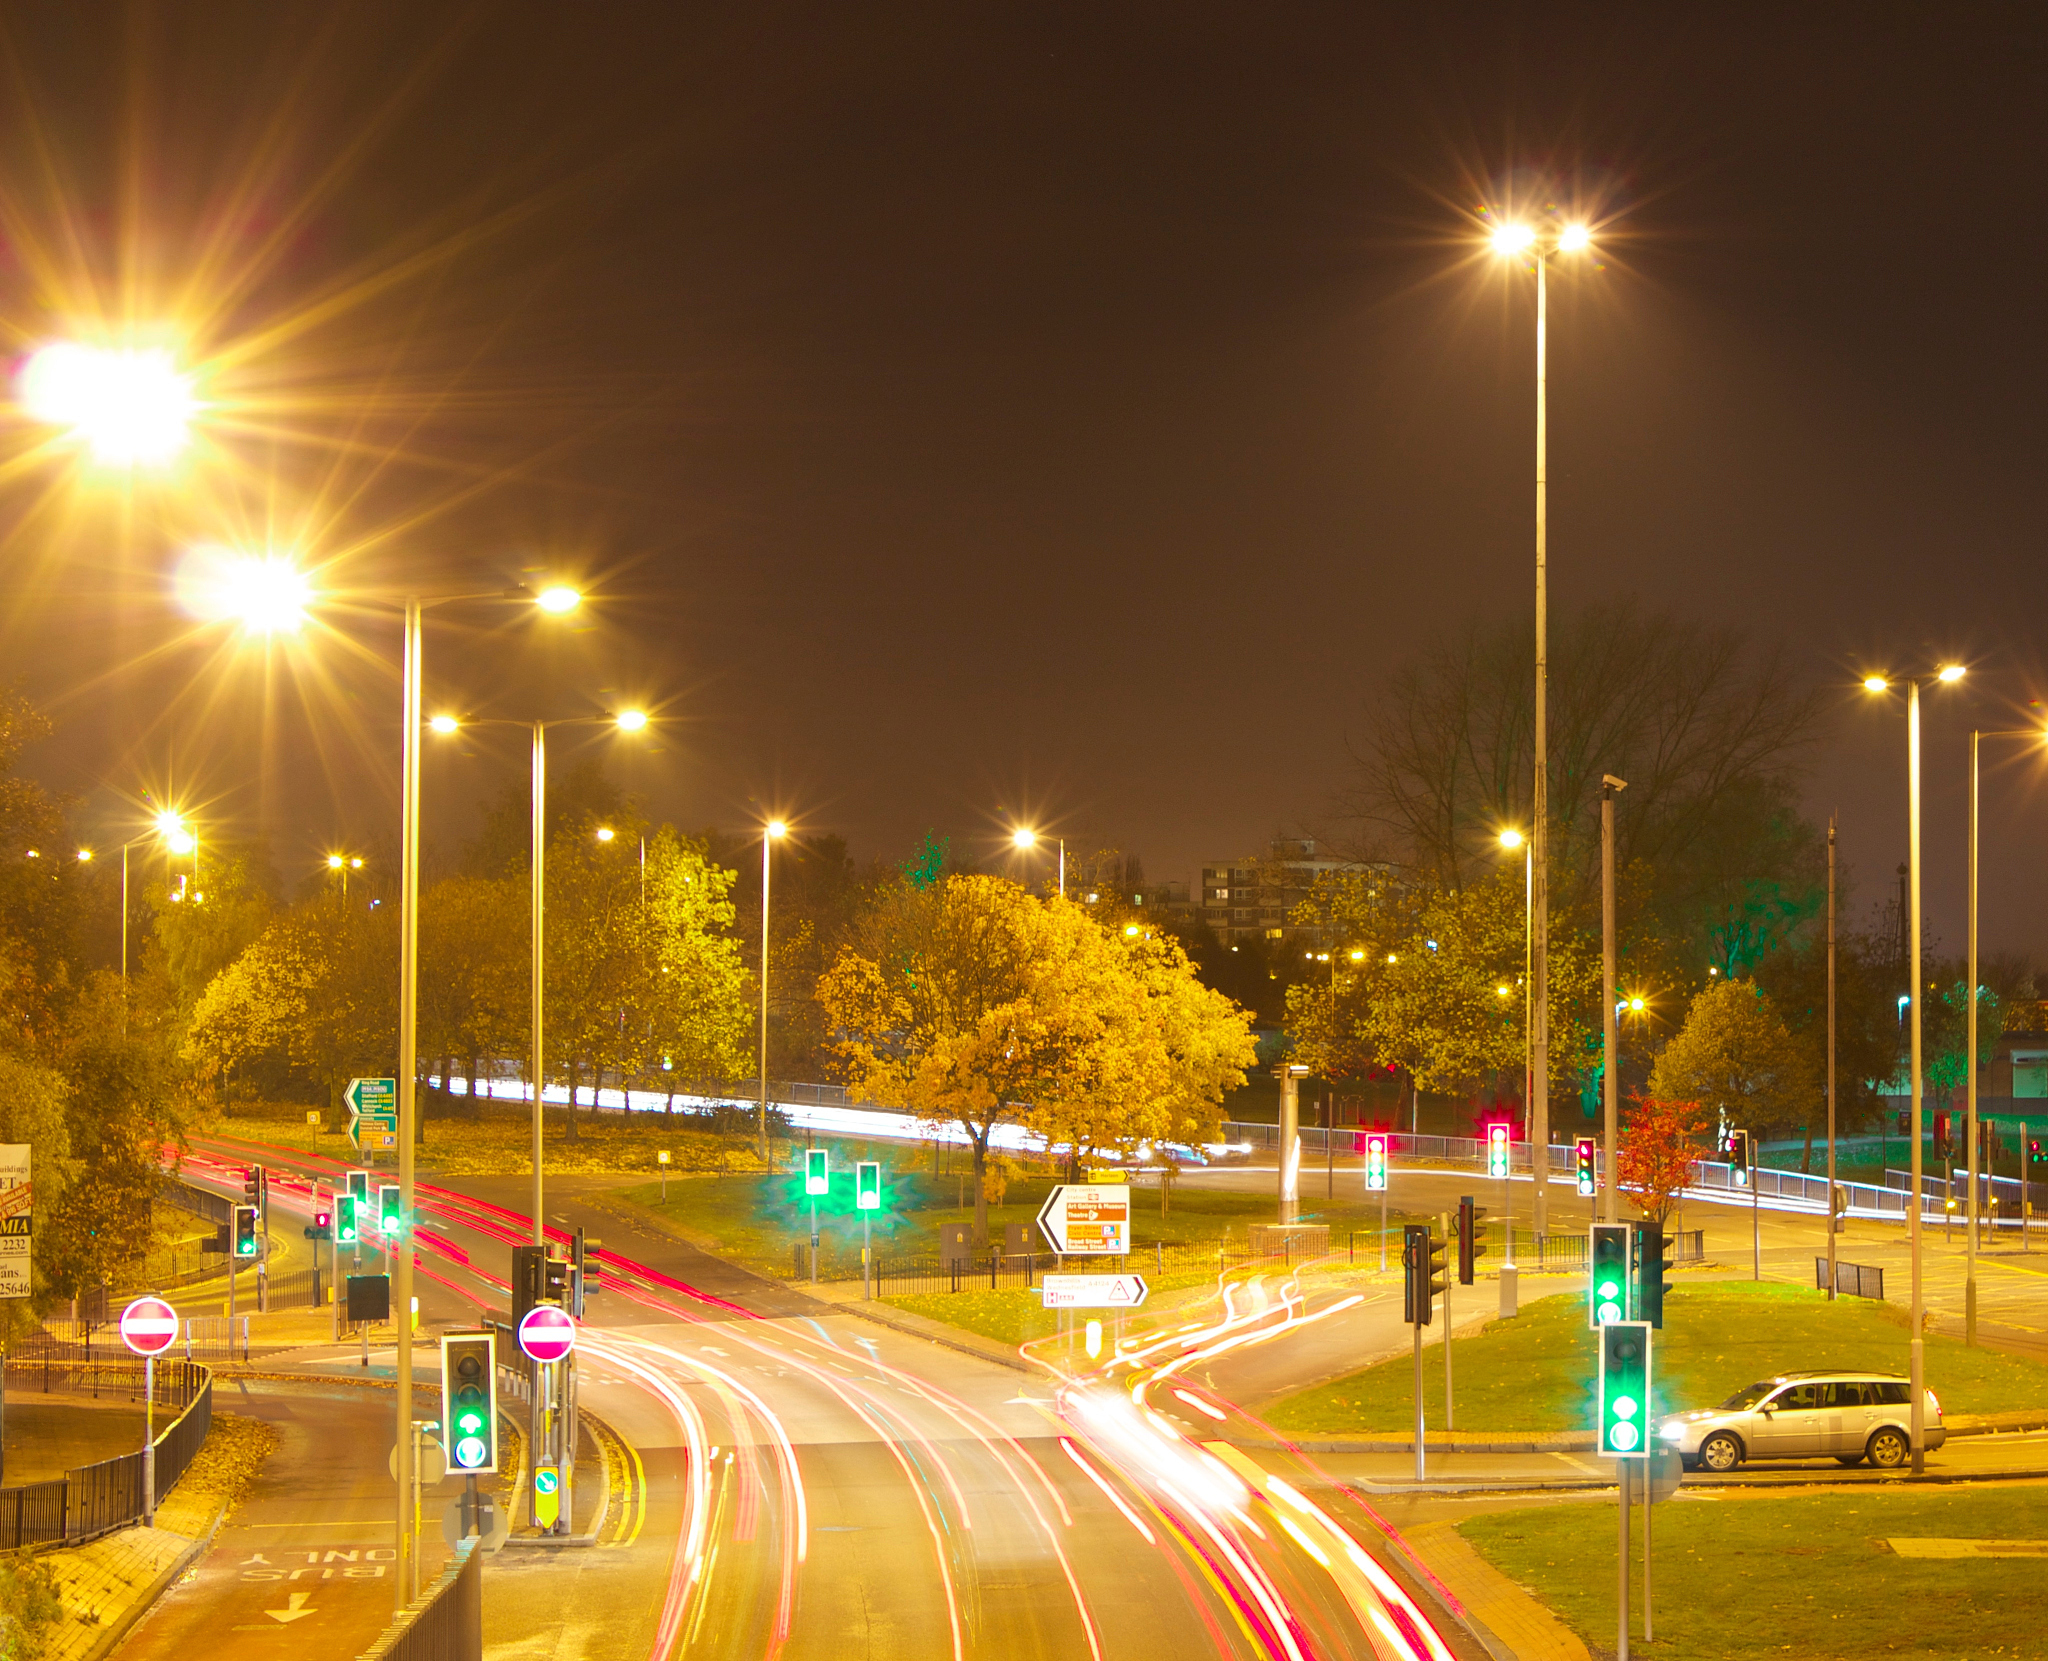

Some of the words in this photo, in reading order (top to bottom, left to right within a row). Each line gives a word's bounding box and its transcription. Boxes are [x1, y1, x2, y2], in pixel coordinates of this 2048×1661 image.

[3, 1239, 25, 1250] 2232
[0, 1282, 30, 1295] 25646
[239, 1549, 397, 1565] ONLY
[239, 1566, 386, 1581] BUS
